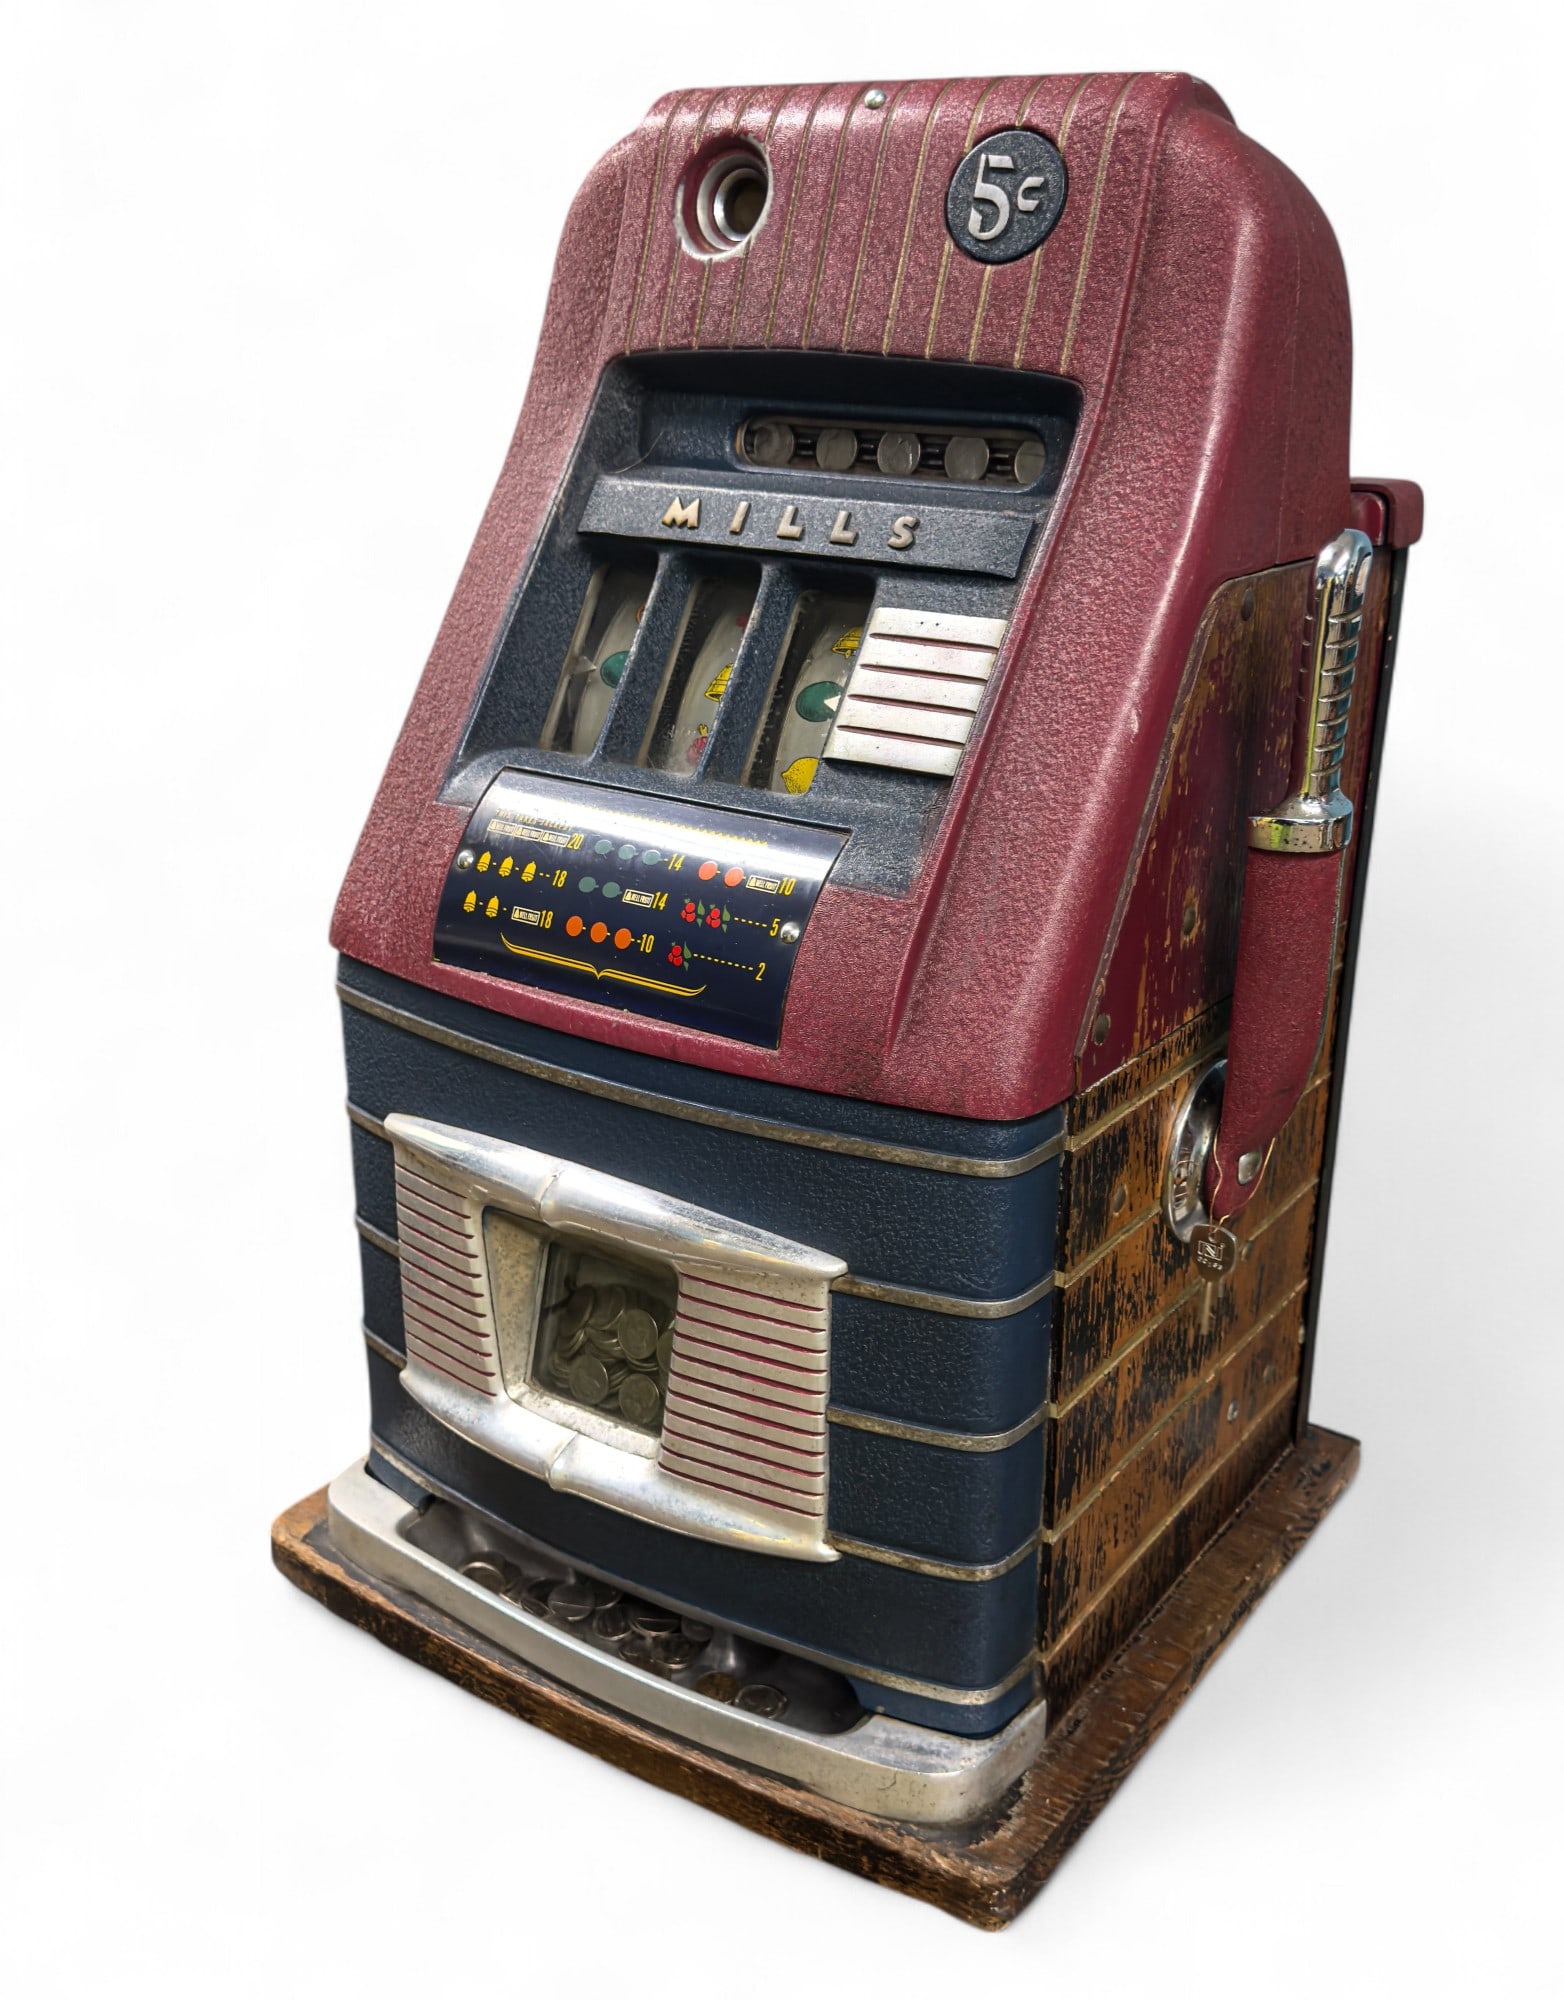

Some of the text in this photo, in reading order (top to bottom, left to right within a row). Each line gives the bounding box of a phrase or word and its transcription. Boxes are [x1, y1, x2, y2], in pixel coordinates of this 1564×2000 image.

[661, 496, 921, 551] MILLS
[567, 832, 585, 850] 20
[668, 853, 685, 871] 14
[552, 869, 568, 888] 18
[778, 877, 797, 896] 10
[652, 891, 669, 911] 14
[540, 910, 554, 929] 18
[769, 918, 781, 937] 5
[640, 933, 655, 953] 10
[755, 962, 766, 981] 2
